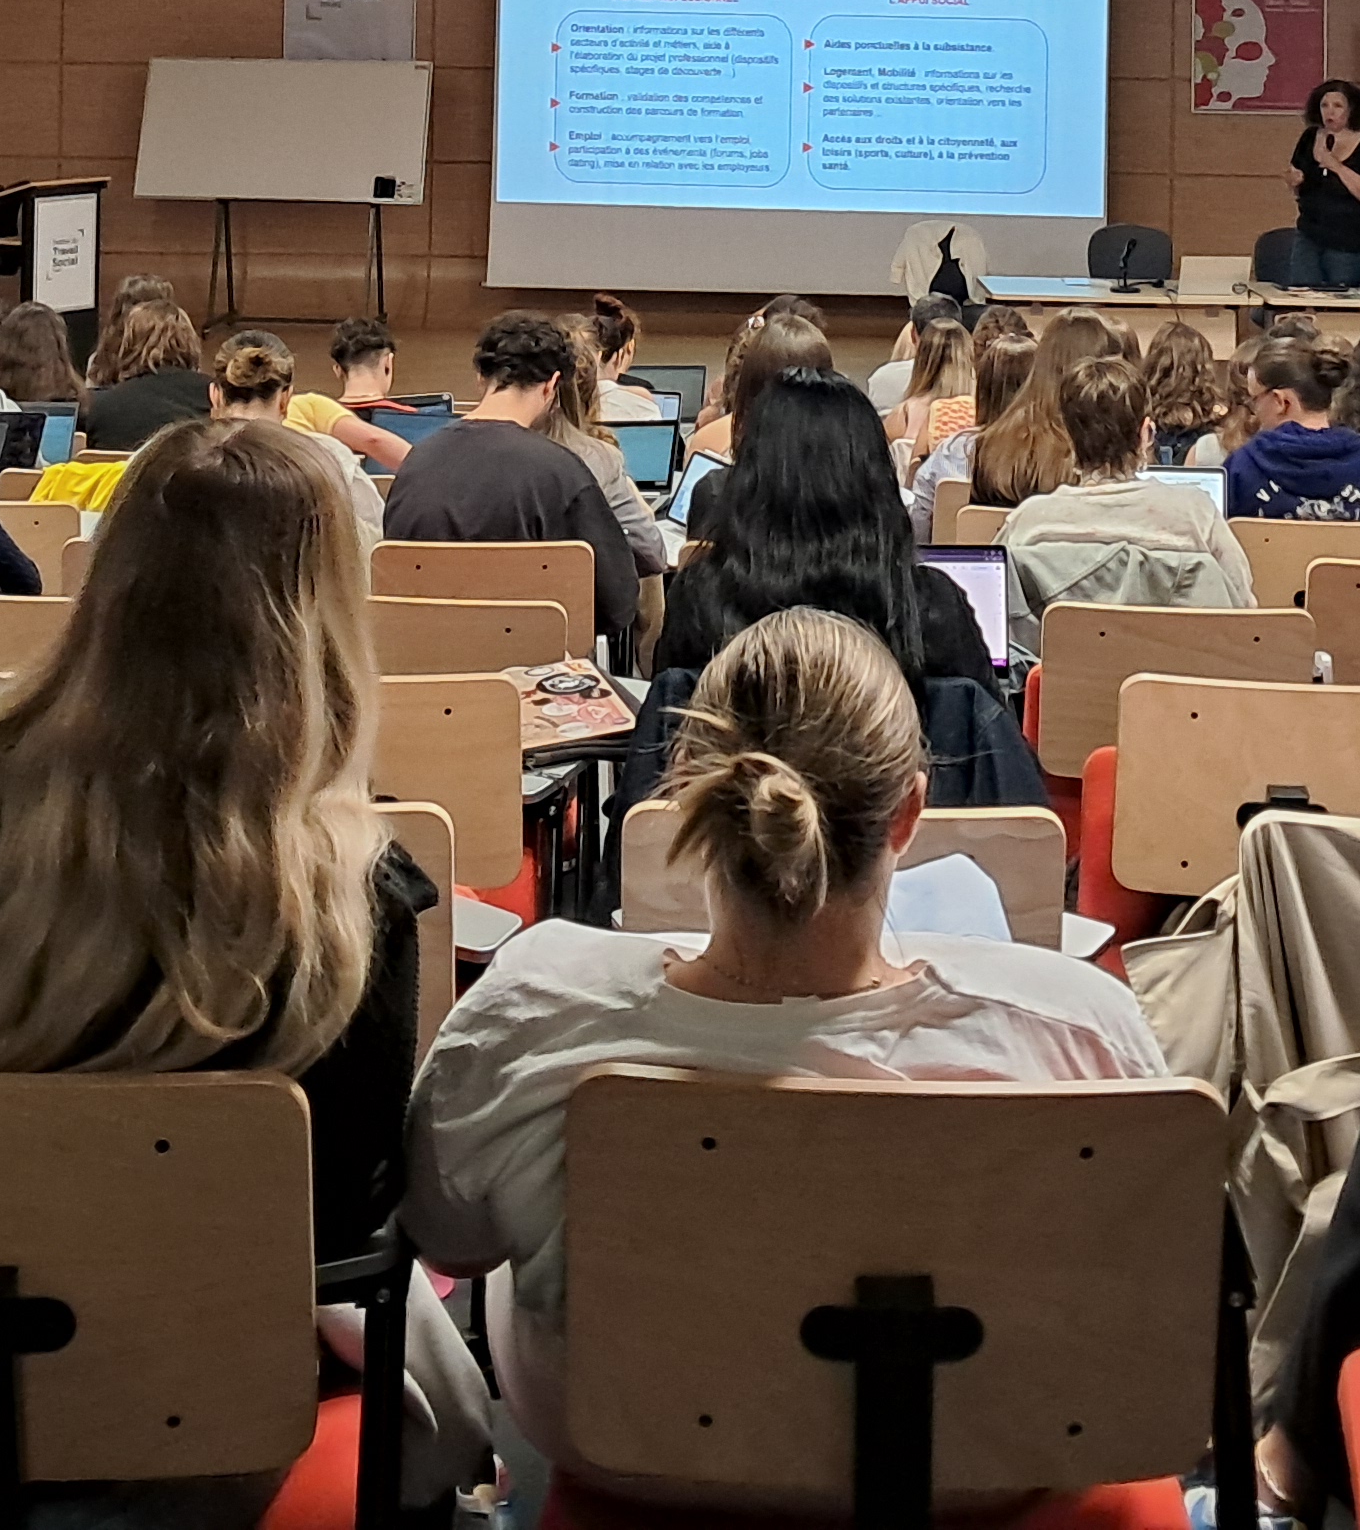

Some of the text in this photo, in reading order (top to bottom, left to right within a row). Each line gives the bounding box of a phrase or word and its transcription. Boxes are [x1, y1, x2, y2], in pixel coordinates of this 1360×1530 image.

[570, 23, 625, 35] Orientation
[633, 25, 688, 36] informations
[690, 27, 705, 37] sur
[707, 26, 721, 37] les
[723, 26, 766, 37] différents
[570, 38, 609, 49] secteurs
[611, 38, 651, 49] d'activité
[652, 39, 662, 50] et
[824, 38, 852, 50] Aides
[854, 40, 911, 52] ponctuelles
[922, 40, 932, 51] la
[570, 51, 625, 62] l'élaboration
[627, 52, 639, 63] du
[641, 53, 666, 65] projet
[668, 53, 729, 65] professionnel
[657, 66, 670, 76] de
[877, 67, 916, 78] Mobilité
[924, 69, 981, 80] informations
[982, 70, 998, 80] sur
[823, 80, 868, 91] dispositifs
[870, 81, 880, 91] et
[881, 81, 927, 92] structures
[985, 83, 1032, 94] recherche
[569, 90, 764, 105] Formation validation des compétences et
[823, 94, 840, 104] des
[841, 94, 883, 105] solutions
[936, 96, 984, 107] orientation
[987, 97, 1007, 107] vers
[1008, 97, 1023, 107] les
[569, 104, 624, 115] construction
[625, 106, 642, 116] des
[645, 107, 685, 118] parcours
[687, 106, 699, 117] de
[569, 130, 602, 142] Emploi
[611, 133, 692, 145] accompagnement
[694, 135, 713, 145] vers
[822, 133, 852, 144] Accès
[854, 135, 873, 145] aux
[875, 135, 904, 145] droits
[906, 136, 916, 146] et
[926, 136, 936, 146] la
[1000, 138, 1018, 148] aux
[568, 145, 623, 157] participation
[633, 146, 650, 156] des
[652, 146, 707, 158] événements
[749, 149, 769, 160] jobs
[822, 147, 853, 158] loisirs
[946, 150, 956, 160] la
[957, 150, 1011, 162] prévention
[603, 159, 626, 170] mise
[628, 160, 640, 170] en
[641, 160, 676, 171] relation
[677, 161, 700, 171] avec
[701, 161, 715, 172] les
